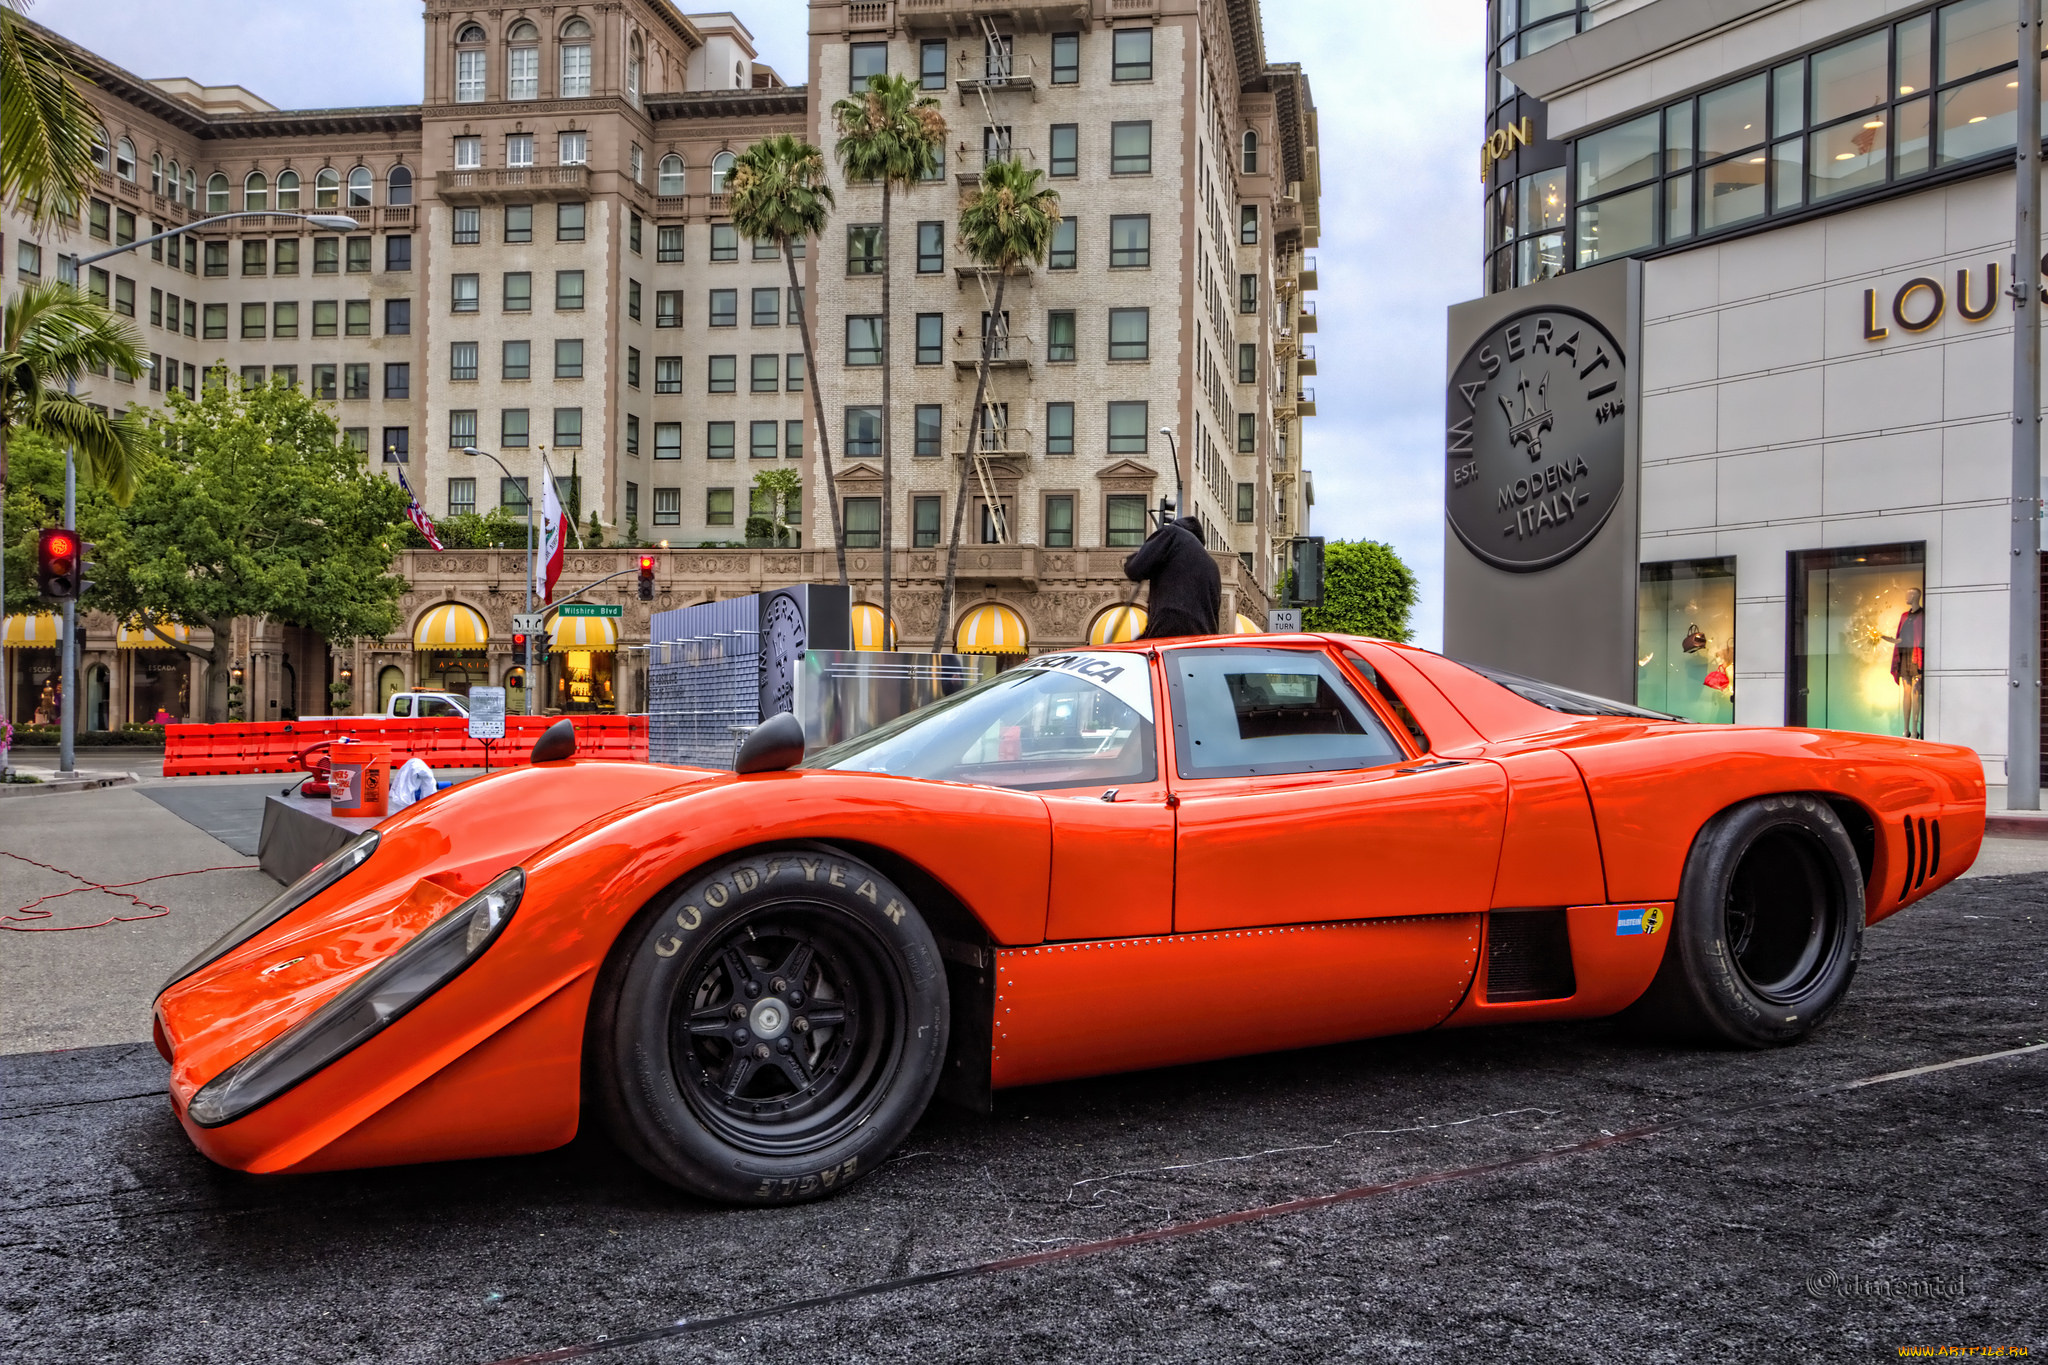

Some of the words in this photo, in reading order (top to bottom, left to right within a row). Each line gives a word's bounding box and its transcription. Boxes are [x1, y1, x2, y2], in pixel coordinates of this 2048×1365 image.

[1863, 252, 2048, 341] LOU
[1447, 317, 1618, 456] MASERATI
[1453, 461, 1479, 487] EST.
[1498, 453, 1589, 511] MODENA
[564, 607, 595, 615] Wilshire
[600, 607, 618, 615] Blvd
[760, 599, 804, 672] MASERATI
[1277, 613, 1292, 621] NO
[754, 1155, 859, 1197] EAGLE
